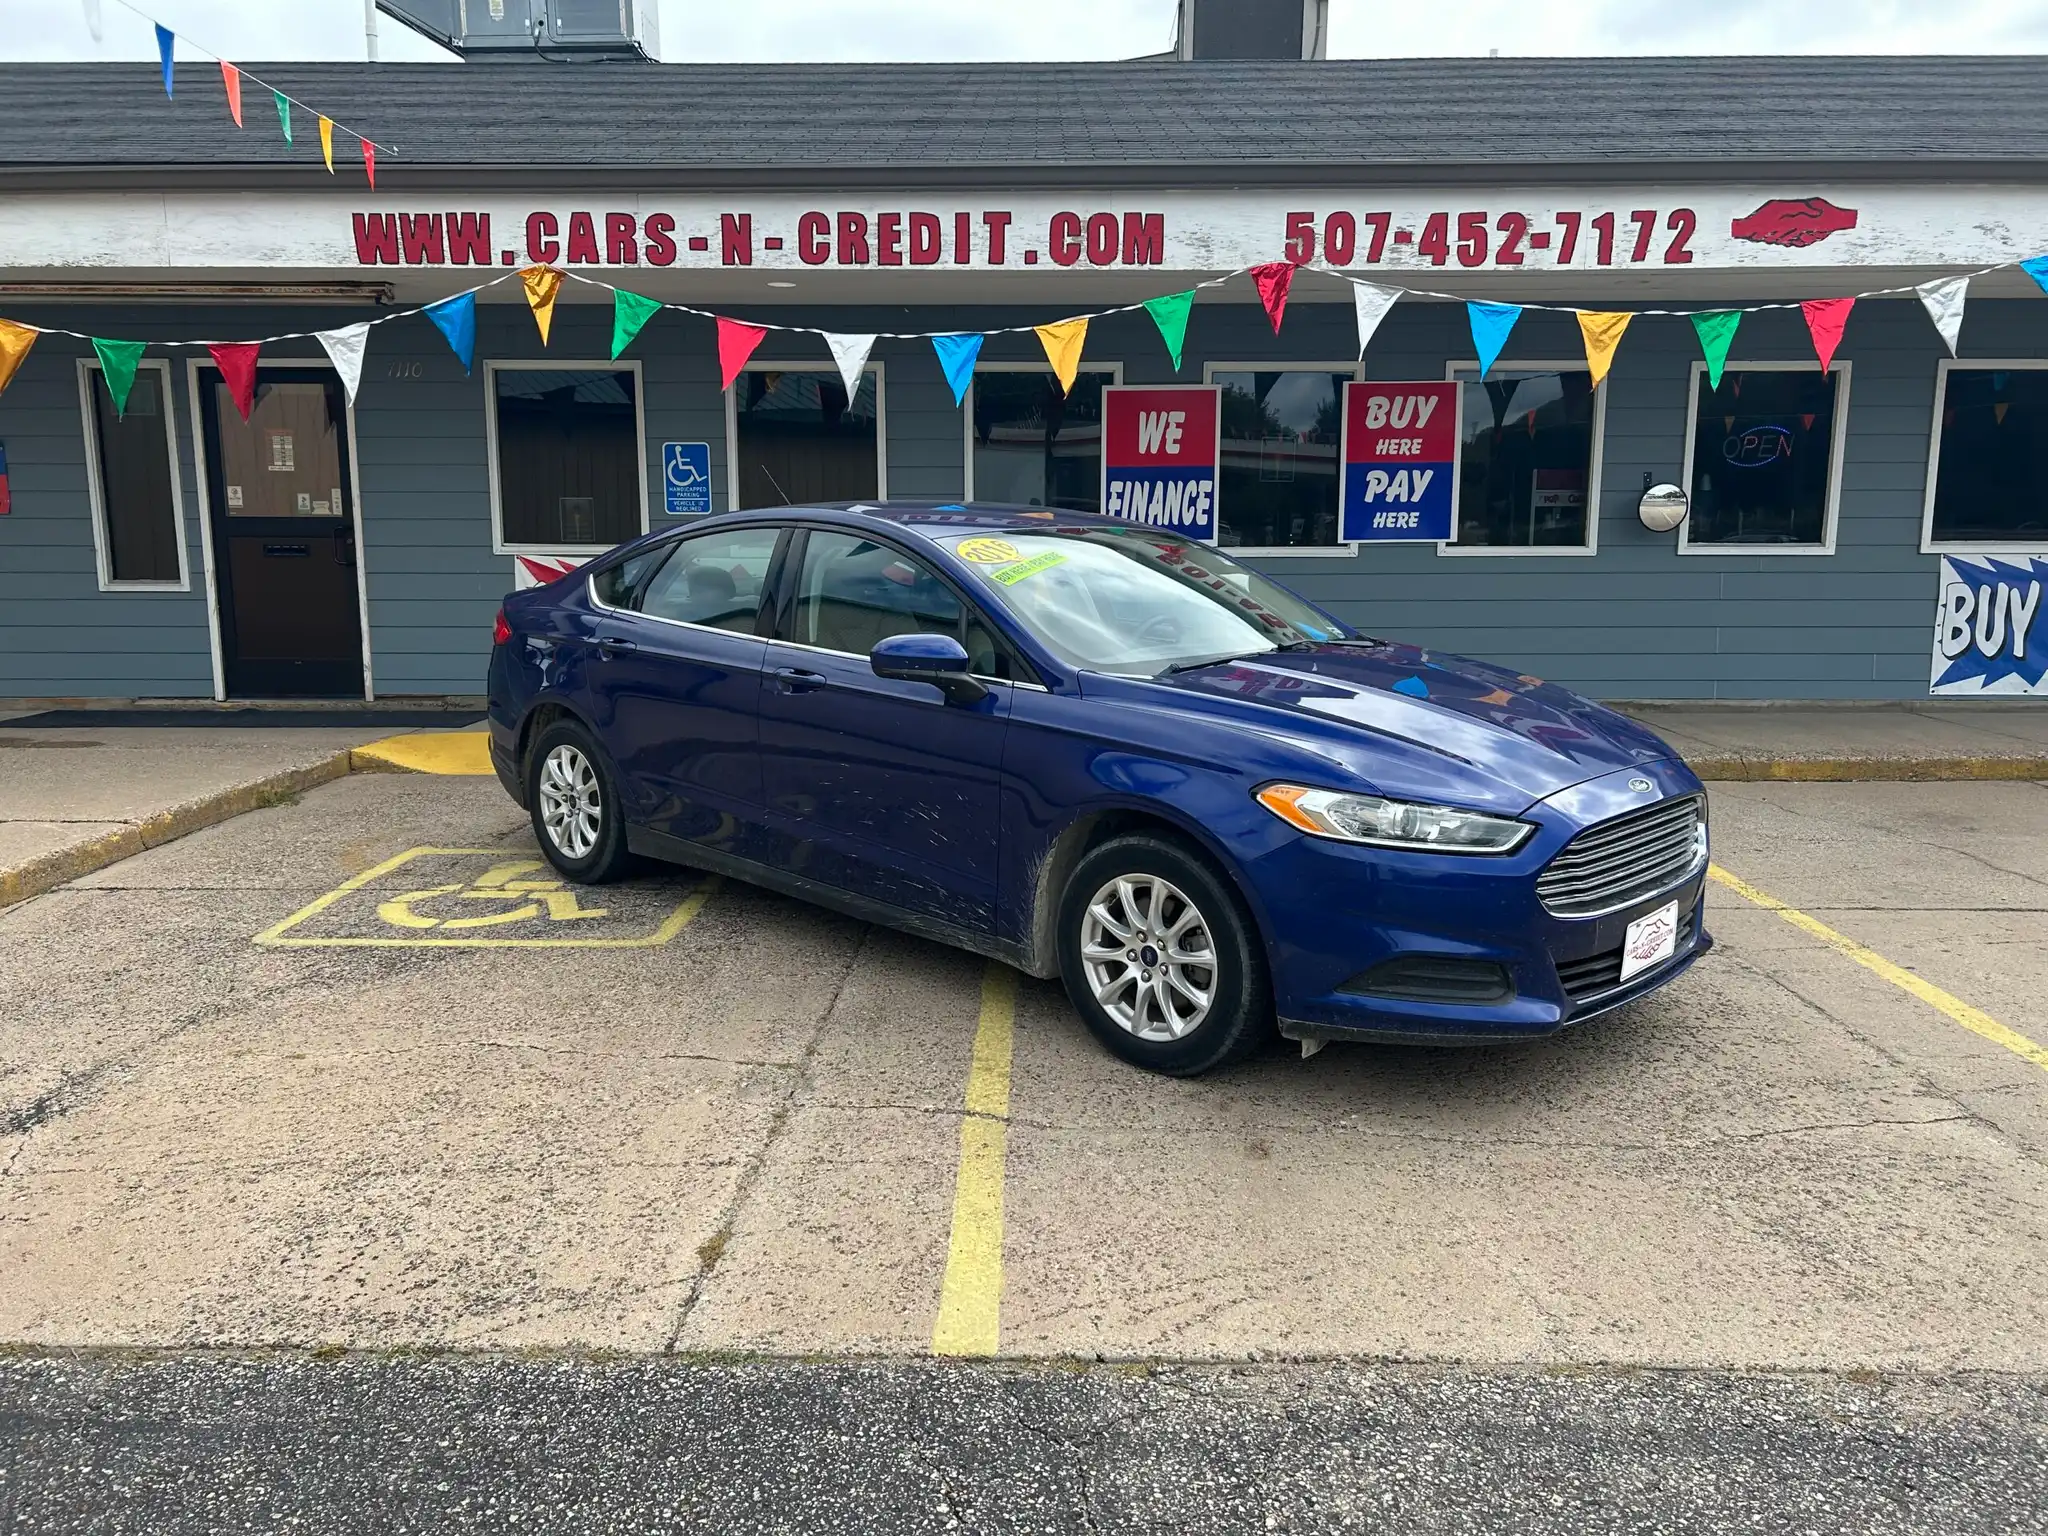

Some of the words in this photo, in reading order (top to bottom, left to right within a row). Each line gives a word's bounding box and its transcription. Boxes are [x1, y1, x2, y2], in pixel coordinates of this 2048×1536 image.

[1285, 208, 1697, 267] 507-452-7172
[1365, 395, 1439, 430] BUY
[1138, 411, 1186, 455] WE
[1375, 438, 1423, 456] HERE
[1722, 434, 1795, 459] OPEN
[1108, 480, 1213, 526] FINANCE
[1364, 469, 1434, 503] PAY
[1373, 511, 1420, 529] HERE
[1941, 579, 2041, 661] BUY
